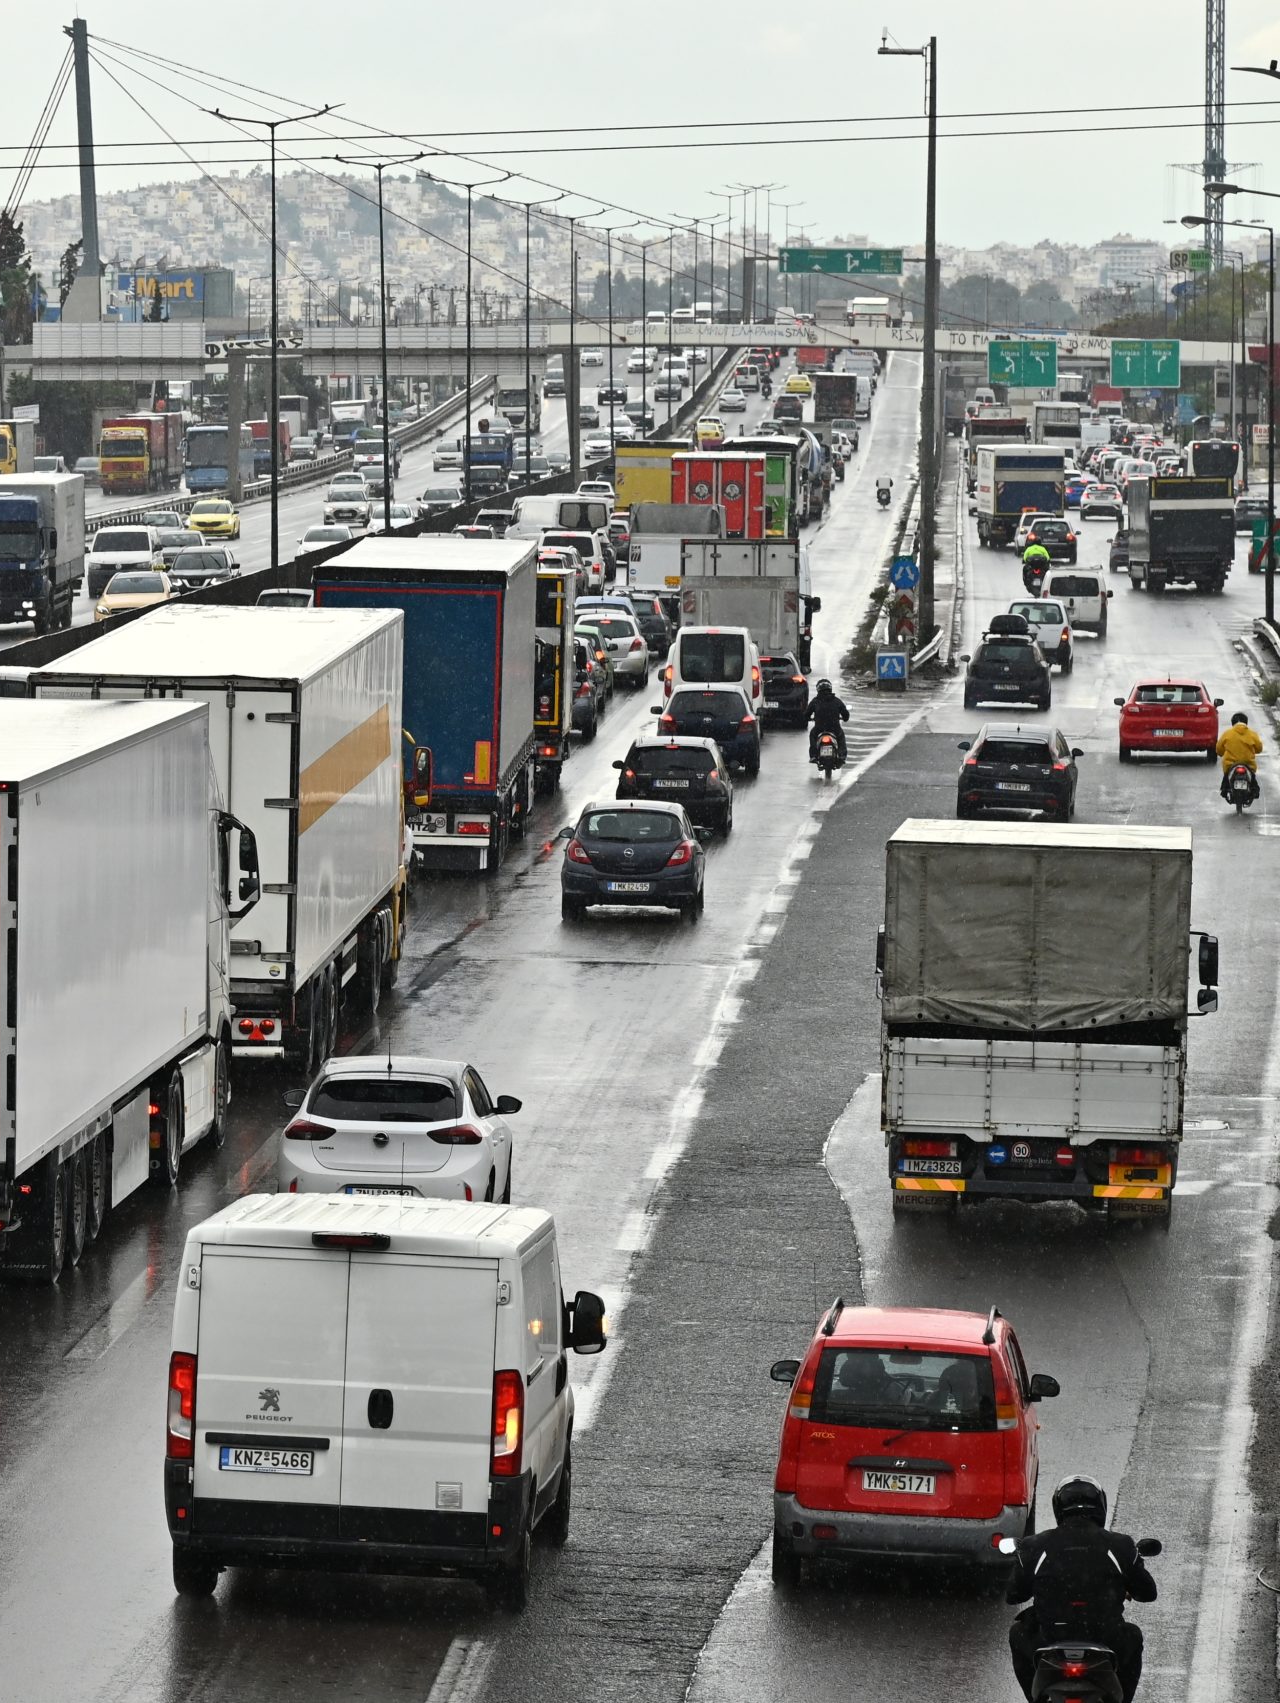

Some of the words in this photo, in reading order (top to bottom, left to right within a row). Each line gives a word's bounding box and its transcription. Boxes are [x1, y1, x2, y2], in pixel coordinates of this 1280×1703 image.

[137, 278, 195, 298] Mart
[1015, 1146, 1027, 1155] 90
[245, 1414, 294, 1422] PEUGEOT
[810, 1431, 836, 1439] ATOS
